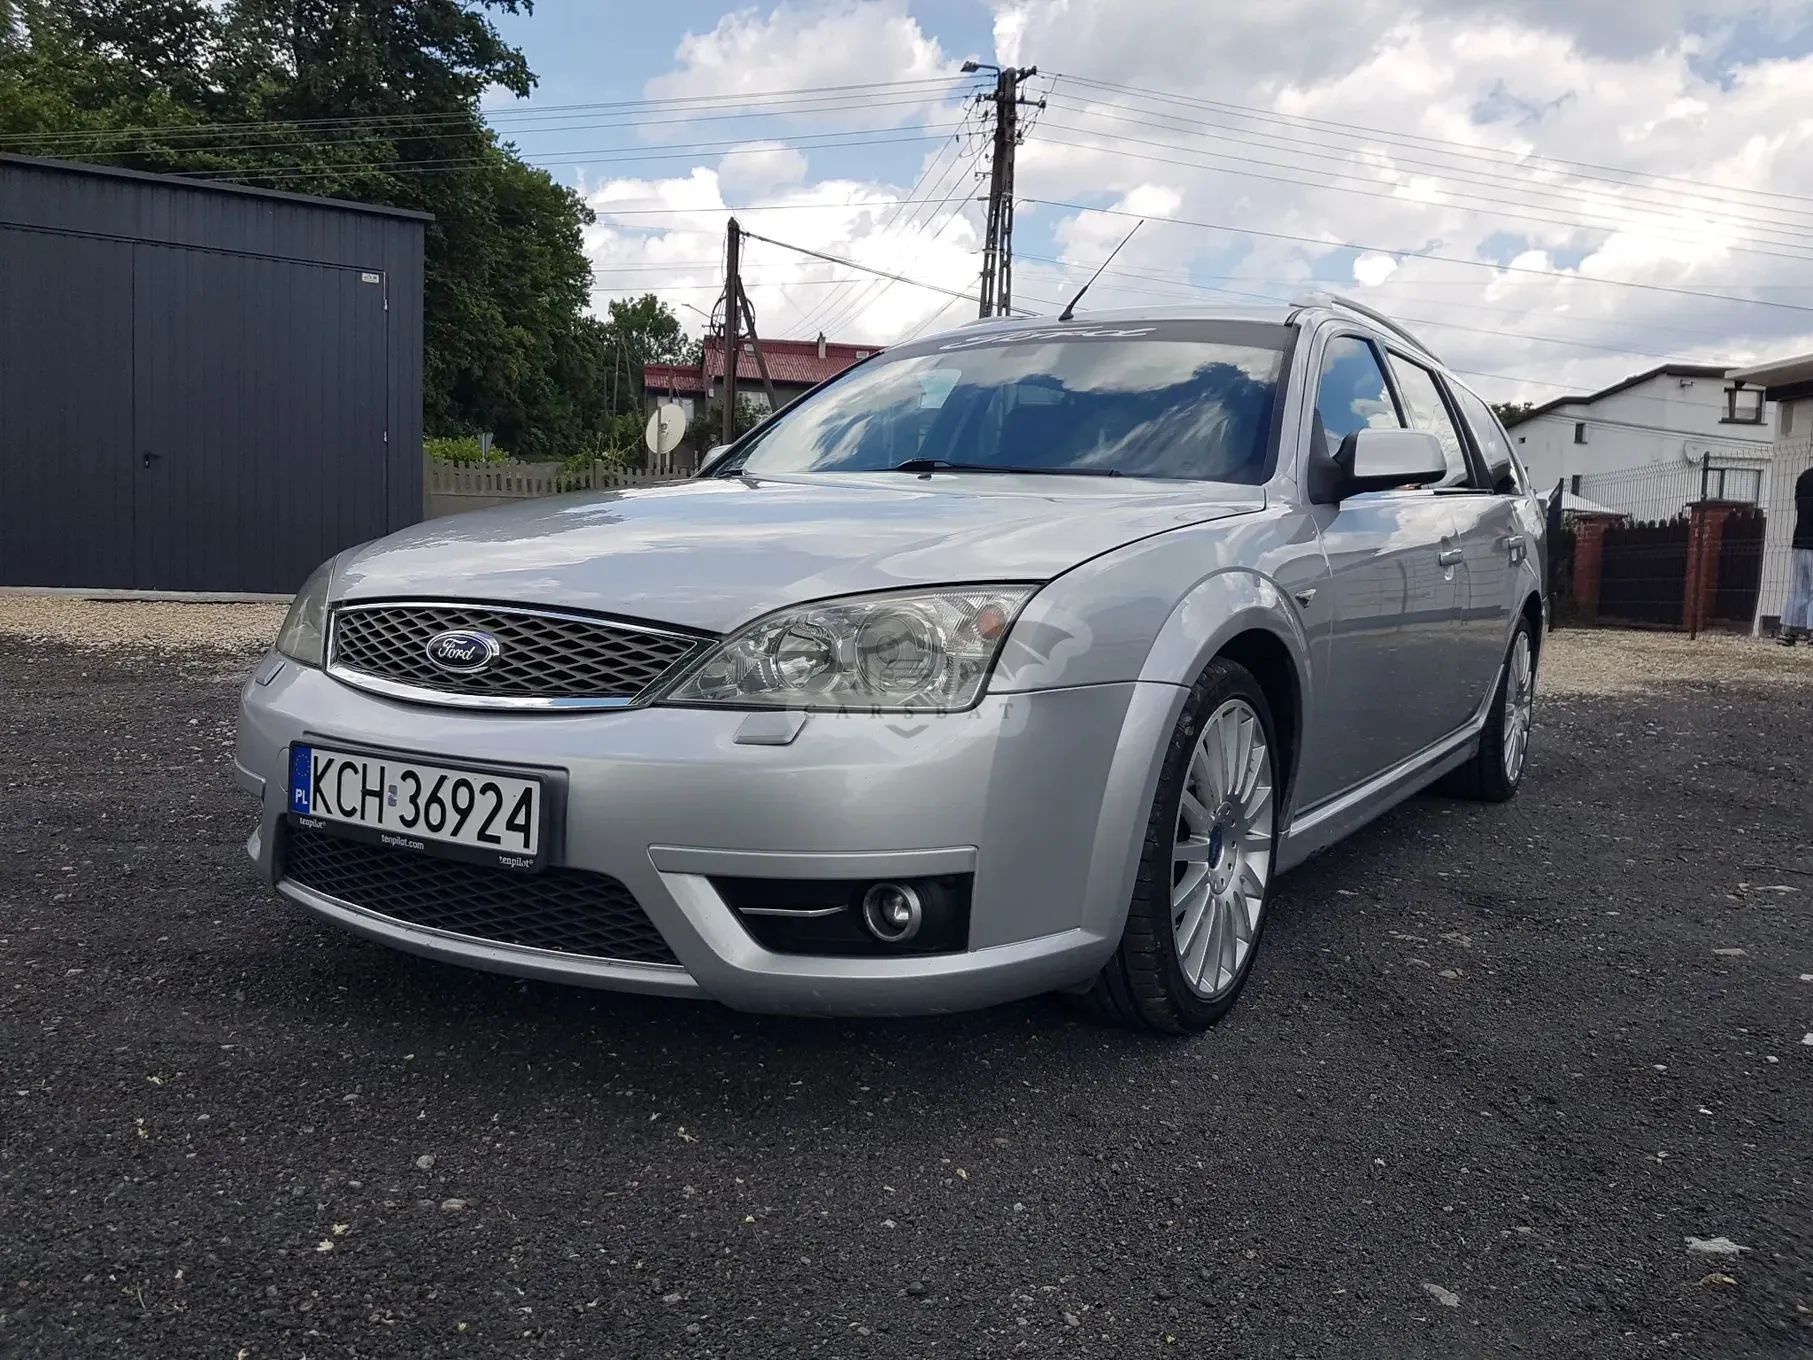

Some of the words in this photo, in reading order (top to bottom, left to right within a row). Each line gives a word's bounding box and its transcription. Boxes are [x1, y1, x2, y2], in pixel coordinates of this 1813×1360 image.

[438, 638, 476, 661] Ford
[295, 788, 308, 805] PL
[312, 755, 386, 824] KCH
[399, 769, 533, 849] 36924
[381, 834, 424, 850] tenpilot.com
